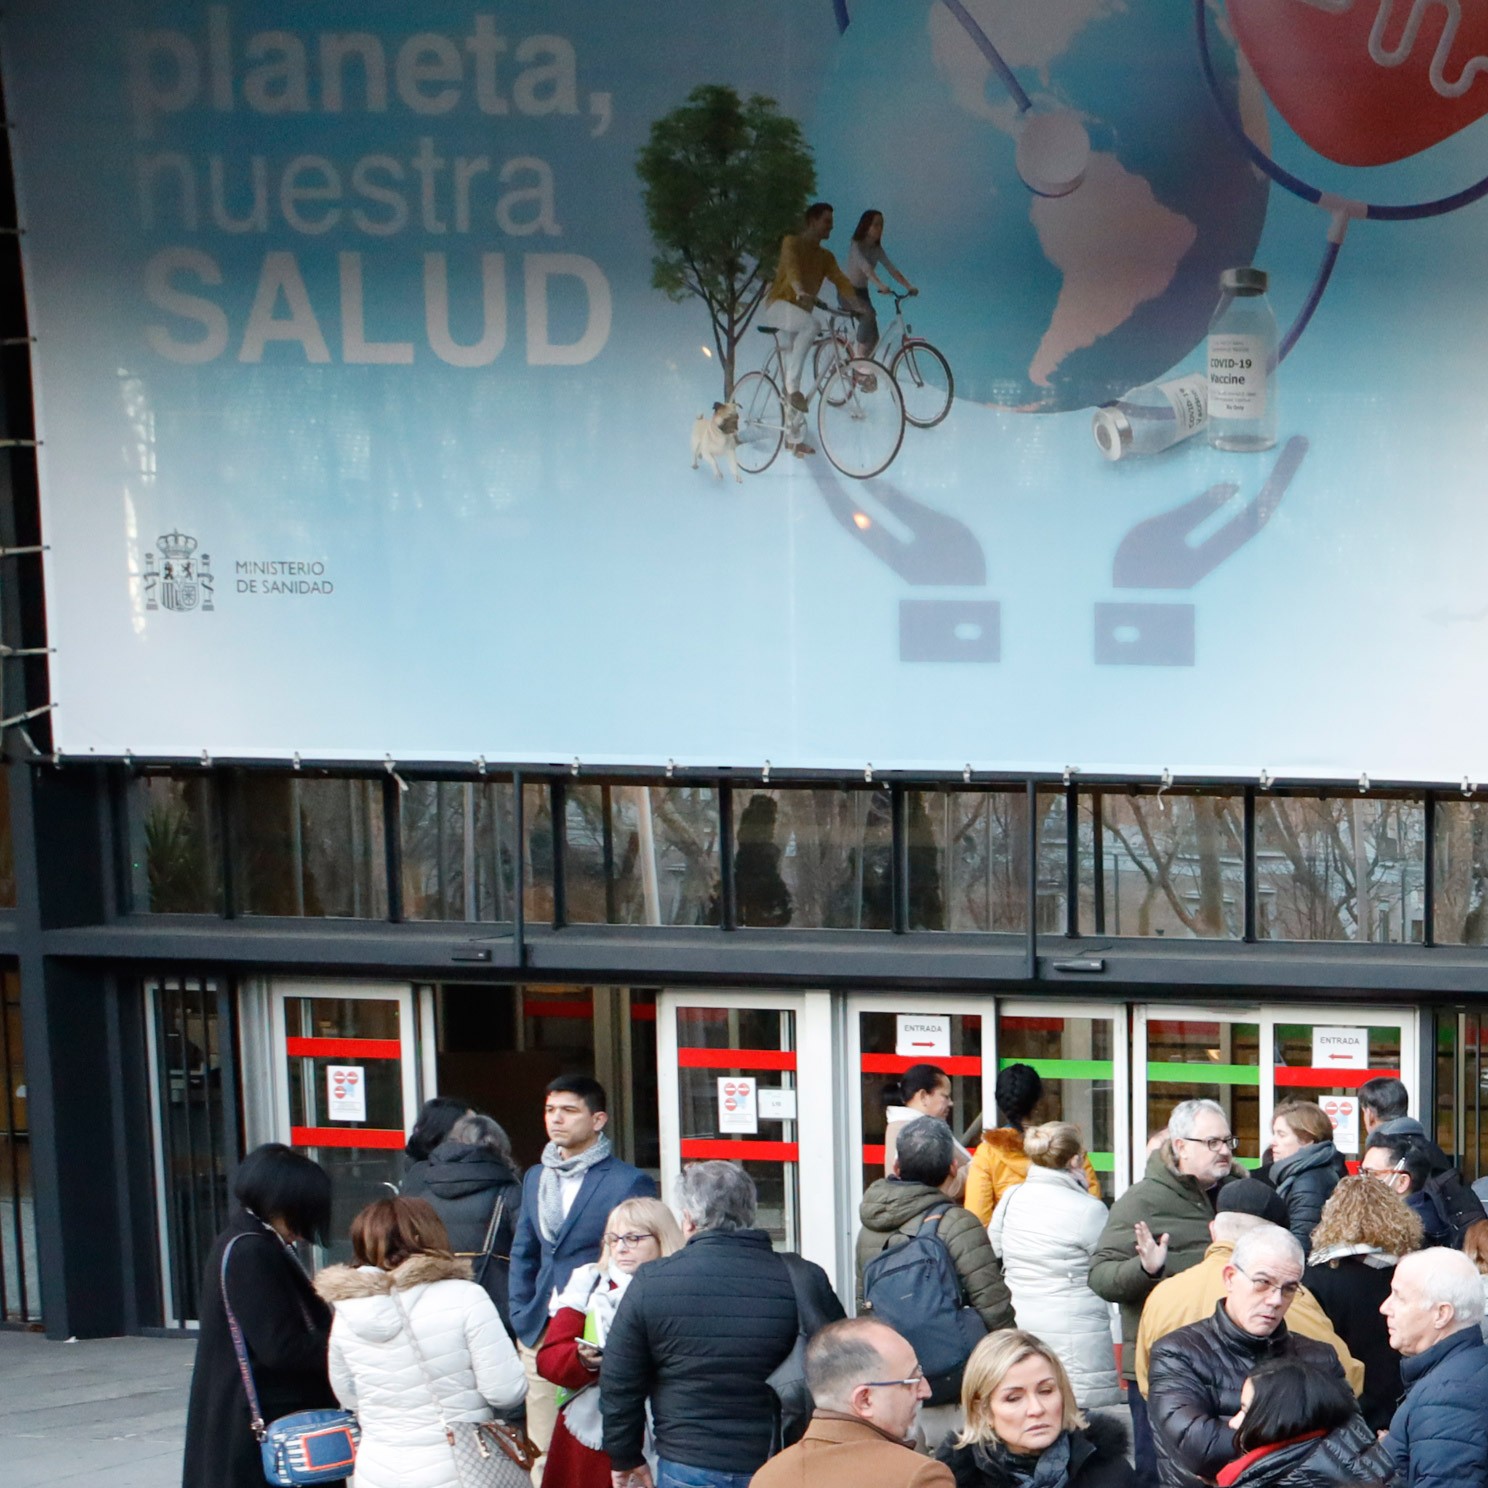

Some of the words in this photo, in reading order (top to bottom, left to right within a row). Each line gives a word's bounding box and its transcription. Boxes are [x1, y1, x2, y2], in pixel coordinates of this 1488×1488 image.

[126, 7, 614, 138] planeta,
[136, 137, 562, 237] nuestra
[144, 247, 613, 366] SALUD
[1210, 358, 1253, 370] COVID-19
[1210, 372, 1246, 385] Vaccine
[235, 561, 325, 576] MINISTERIO
[236, 580, 258, 593] DE
[262, 580, 334, 595] SANIDAD
[904, 1024, 942, 1033] ENTRADA
[1320, 1036, 1360, 1045] ENTRADA
